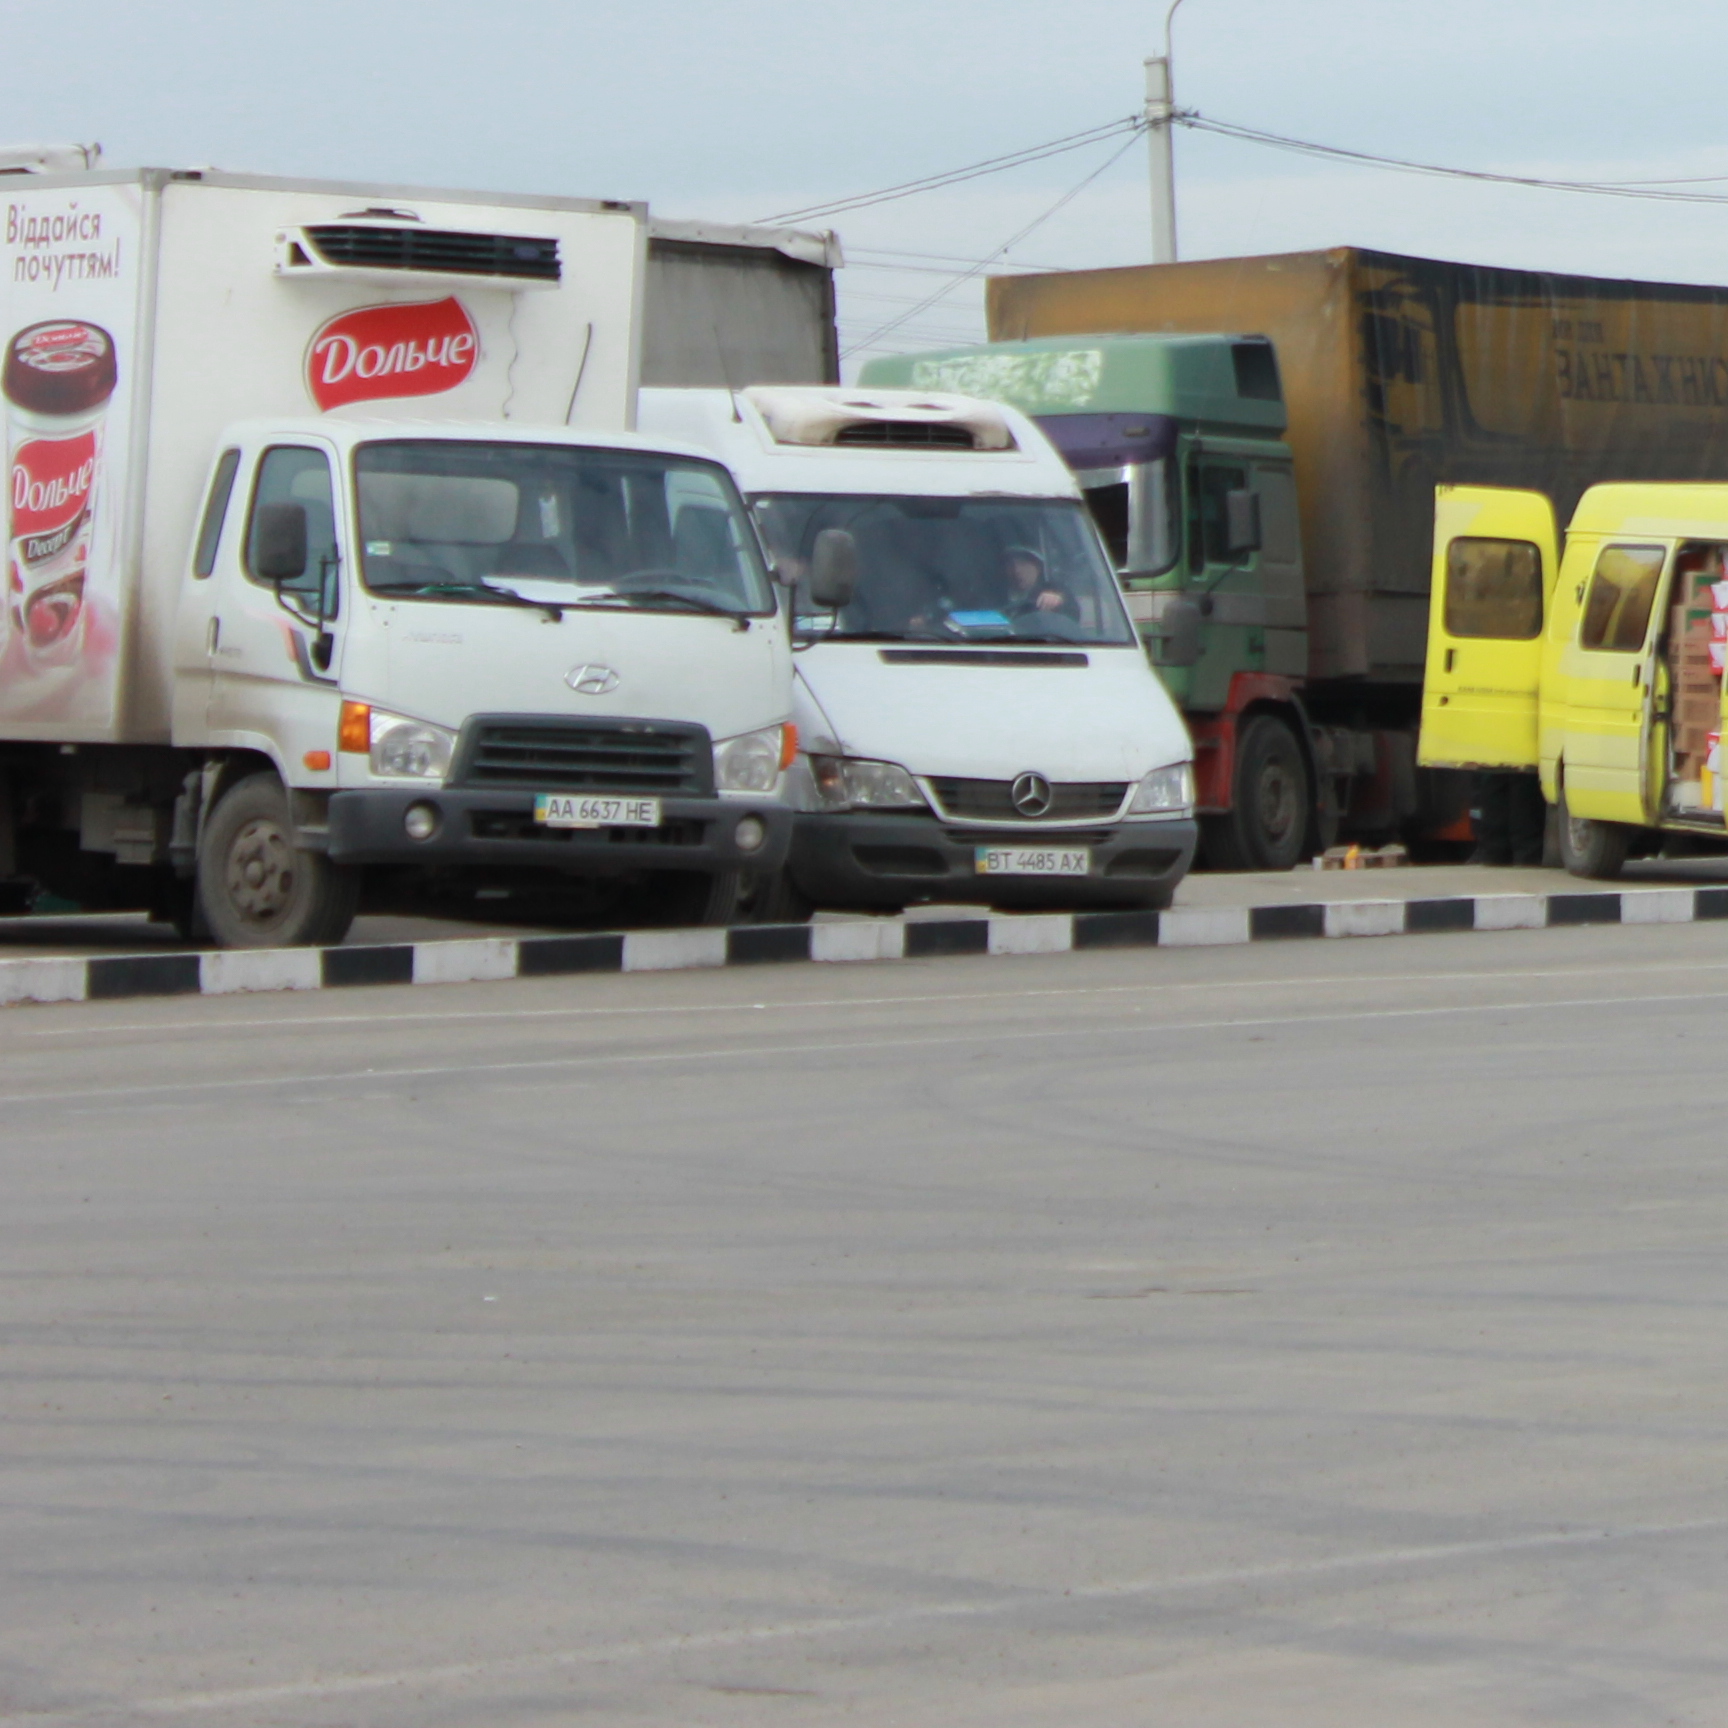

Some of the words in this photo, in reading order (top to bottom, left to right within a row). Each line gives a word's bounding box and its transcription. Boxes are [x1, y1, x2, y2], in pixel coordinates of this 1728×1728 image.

[6, 202, 101, 249] Віддайся
[14, 237, 121, 292] почуттям!
[315, 333, 474, 384] Дольче
[13, 457, 94, 511] Дольче
[547, 799, 573, 818] AA
[579, 800, 621, 820] 6637
[626, 802, 652, 821] HE
[987, 853, 1012, 870] BT
[1017, 853, 1055, 870] 4485
[1060, 853, 1085, 871] AX
